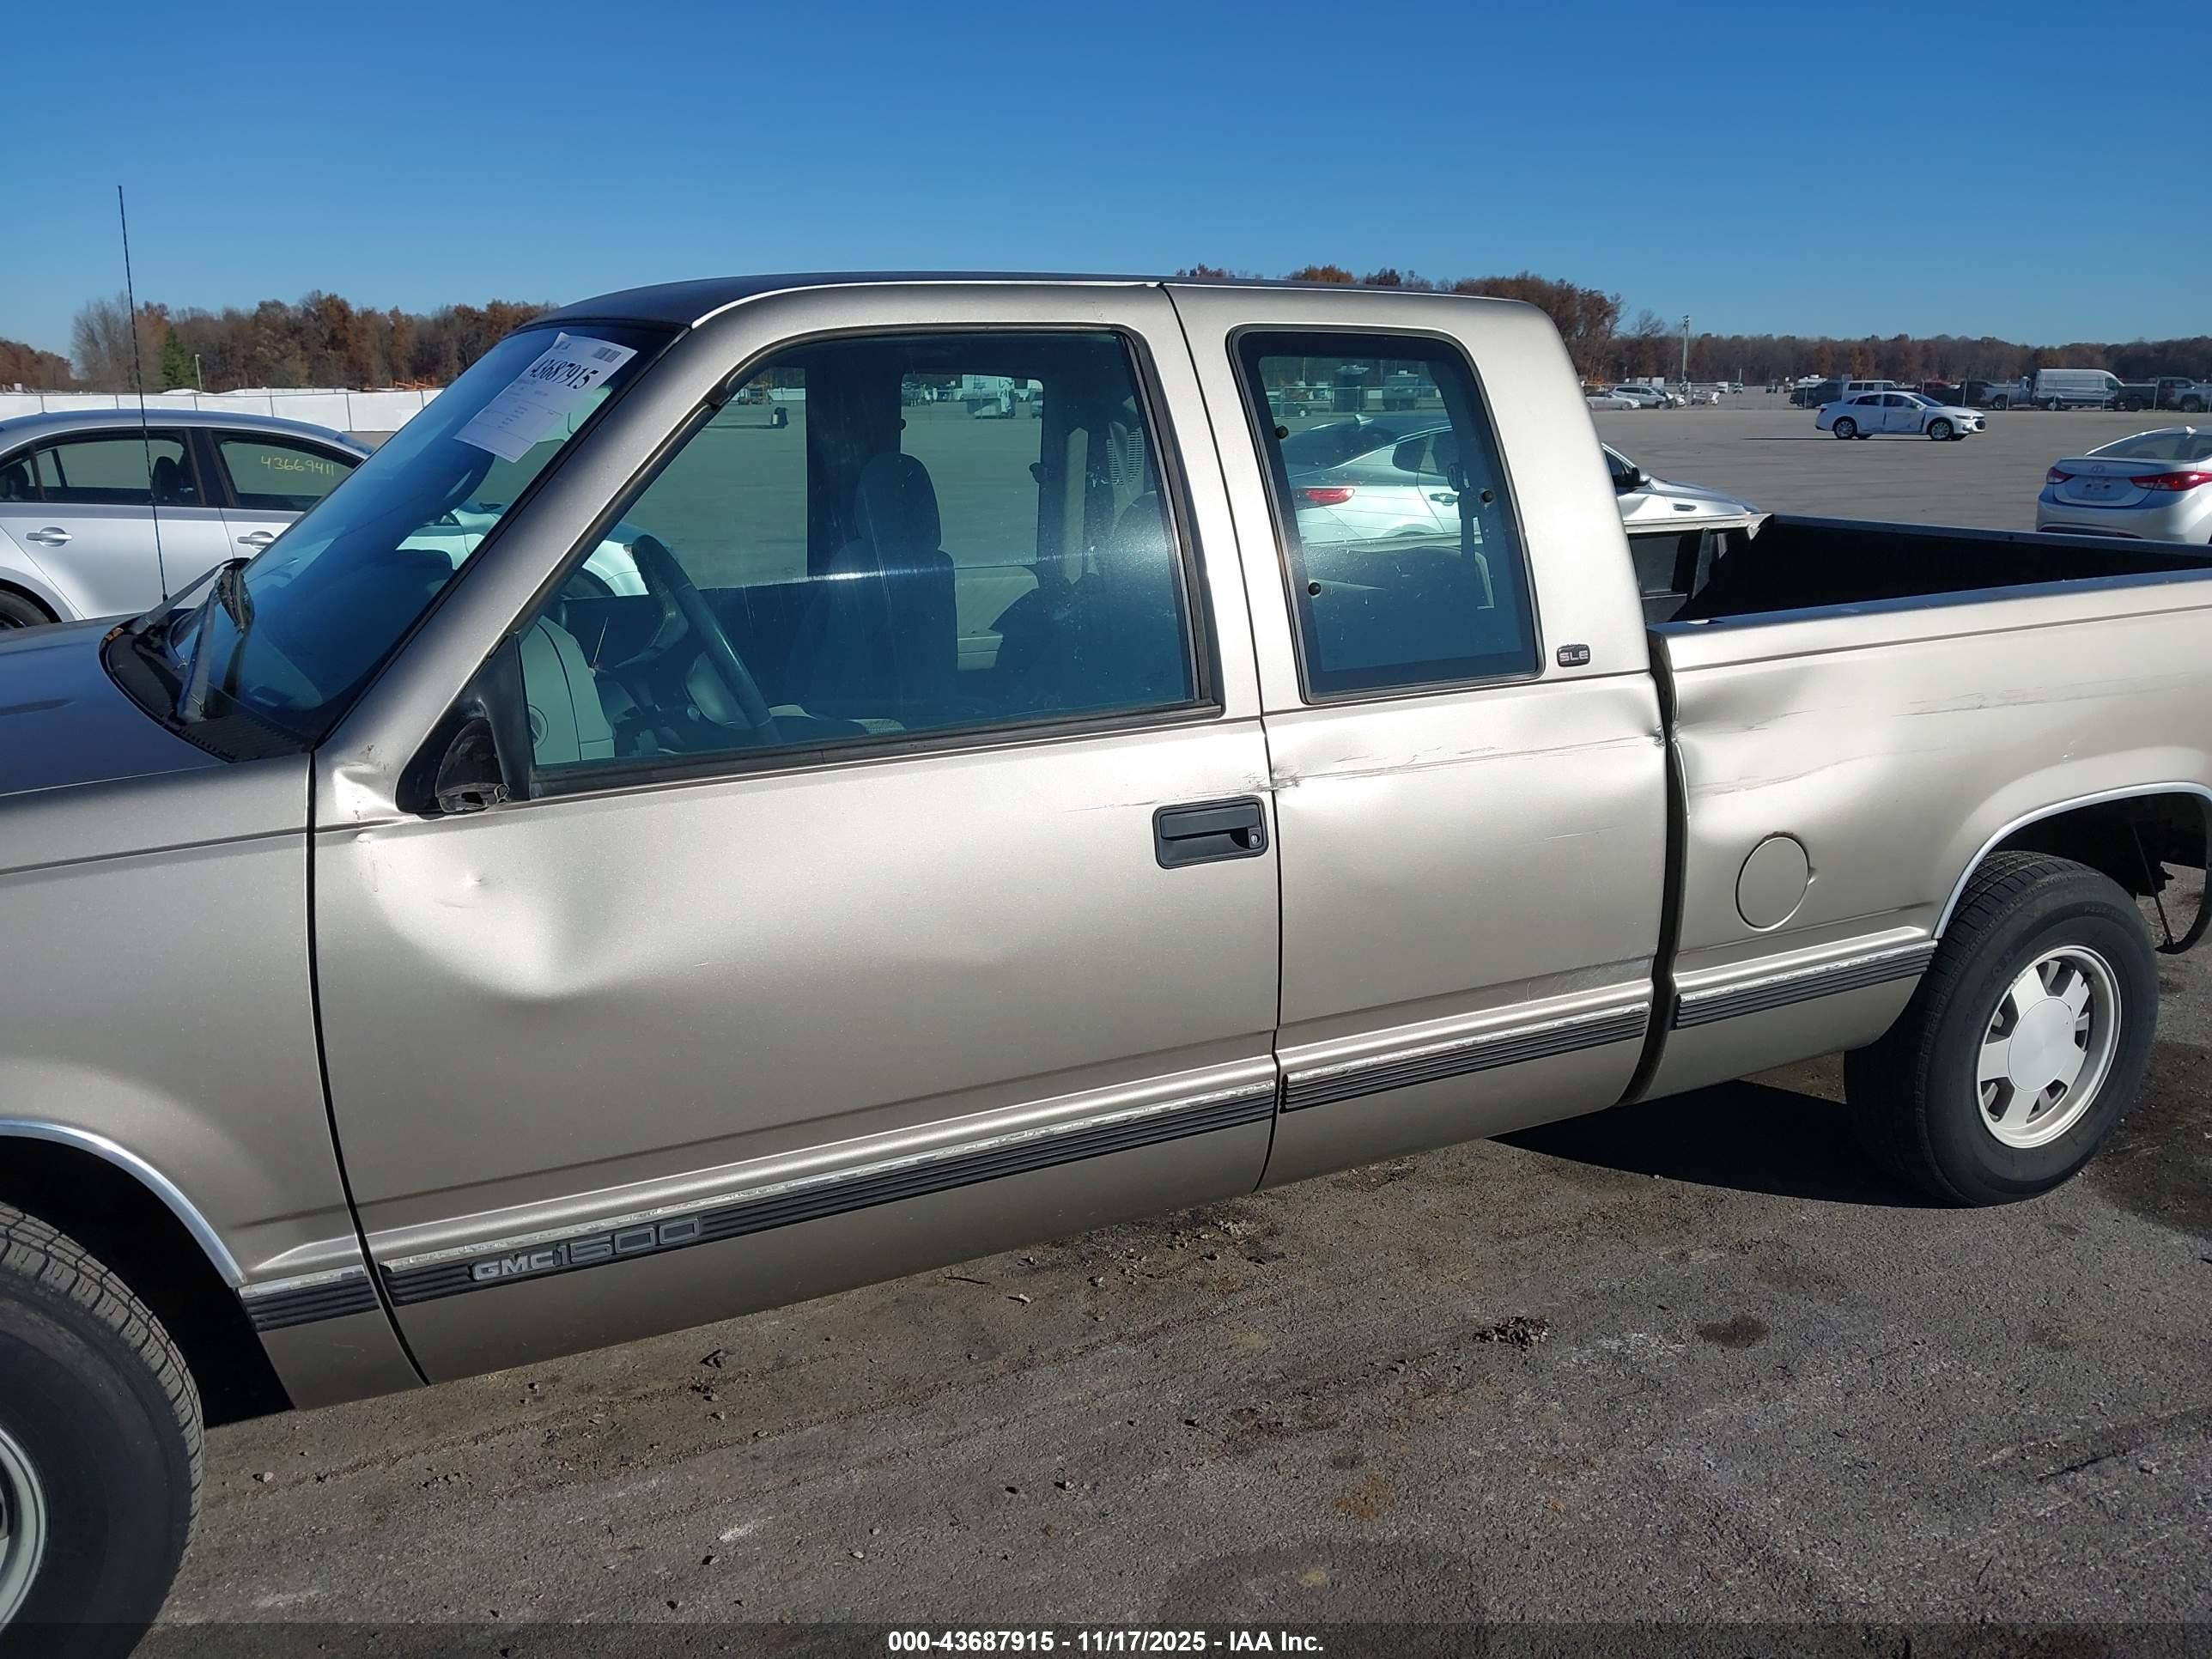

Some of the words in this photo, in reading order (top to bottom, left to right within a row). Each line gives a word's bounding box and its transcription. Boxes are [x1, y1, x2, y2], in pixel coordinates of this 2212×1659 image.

[530, 357, 599, 390] 43687915
[260, 455, 335, 477] 43669411
[1559, 650, 1589, 662] SLE
[471, 1249, 554, 1282] GMC
[554, 1216, 702, 1267] 1500
